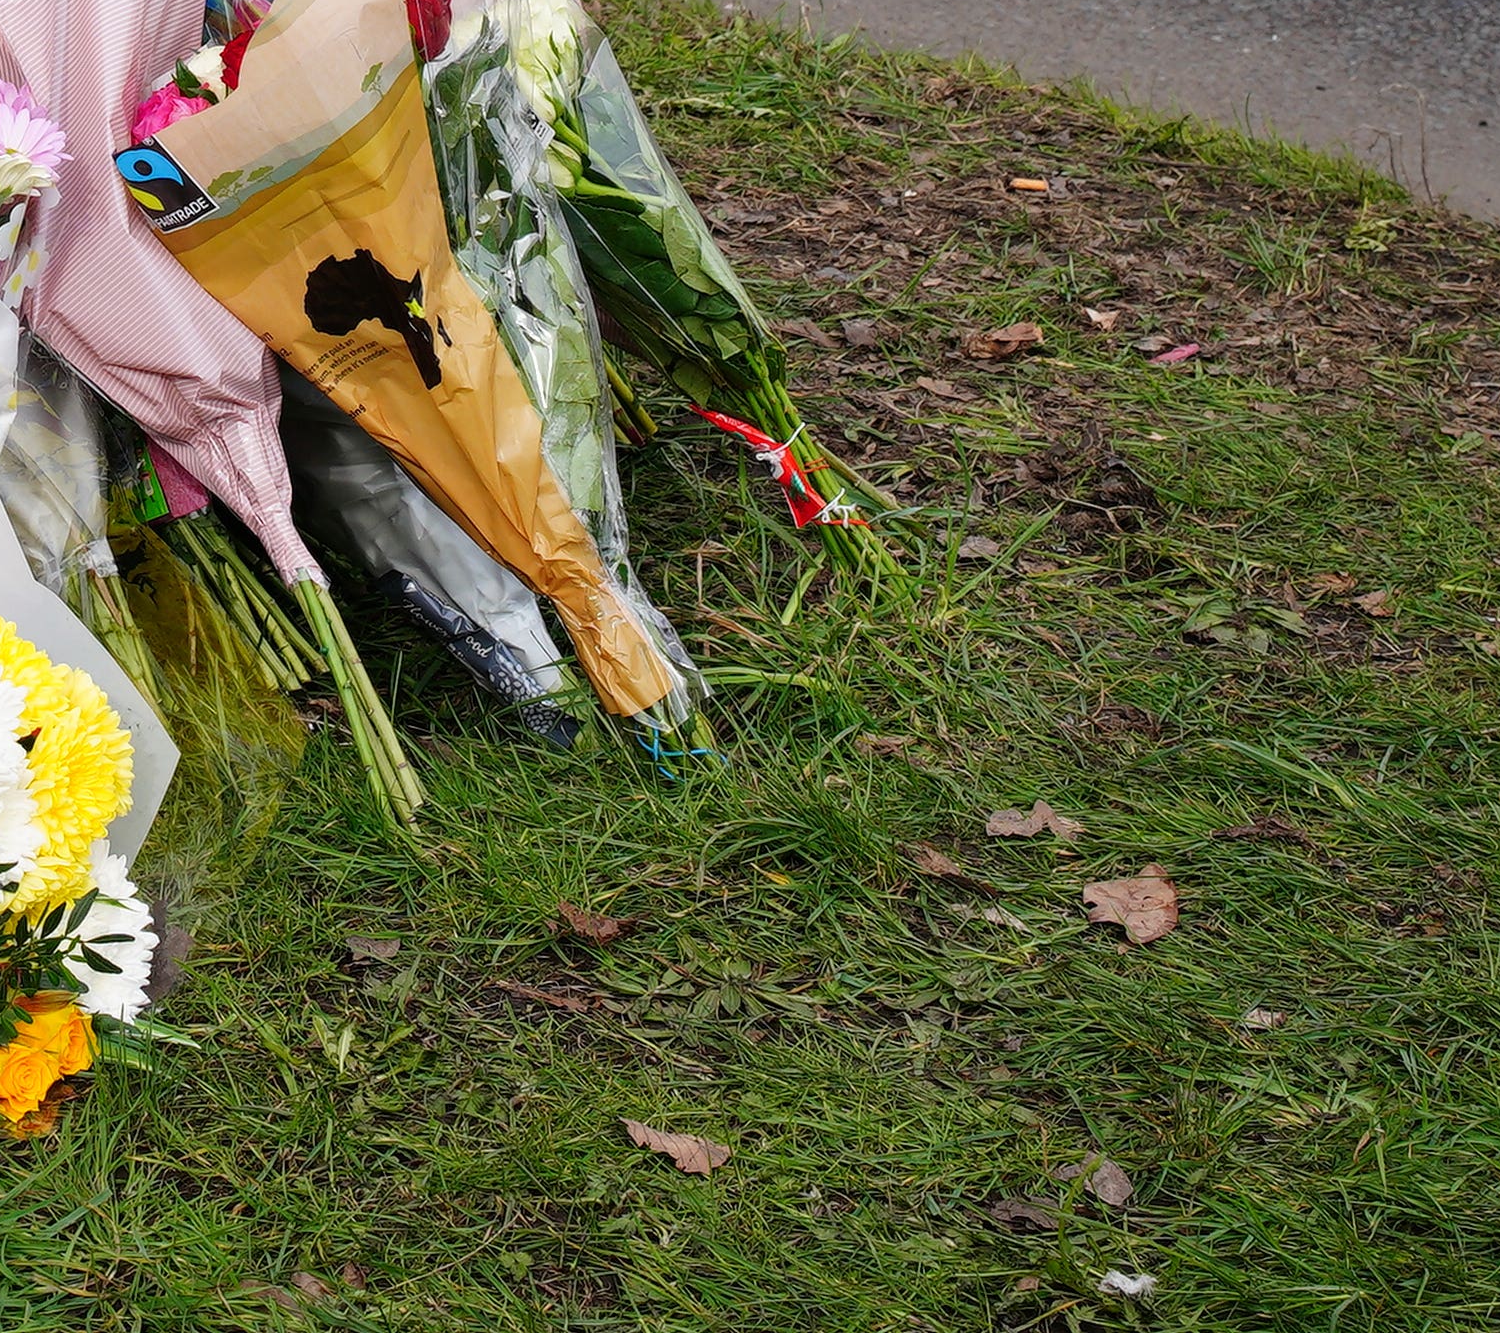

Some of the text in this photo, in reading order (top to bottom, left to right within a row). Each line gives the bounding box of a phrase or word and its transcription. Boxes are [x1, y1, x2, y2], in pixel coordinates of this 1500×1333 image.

[153, 196, 211, 229] FAIRTRADE
[329, 343, 345, 360] paid
[330, 353, 351, 369] which
